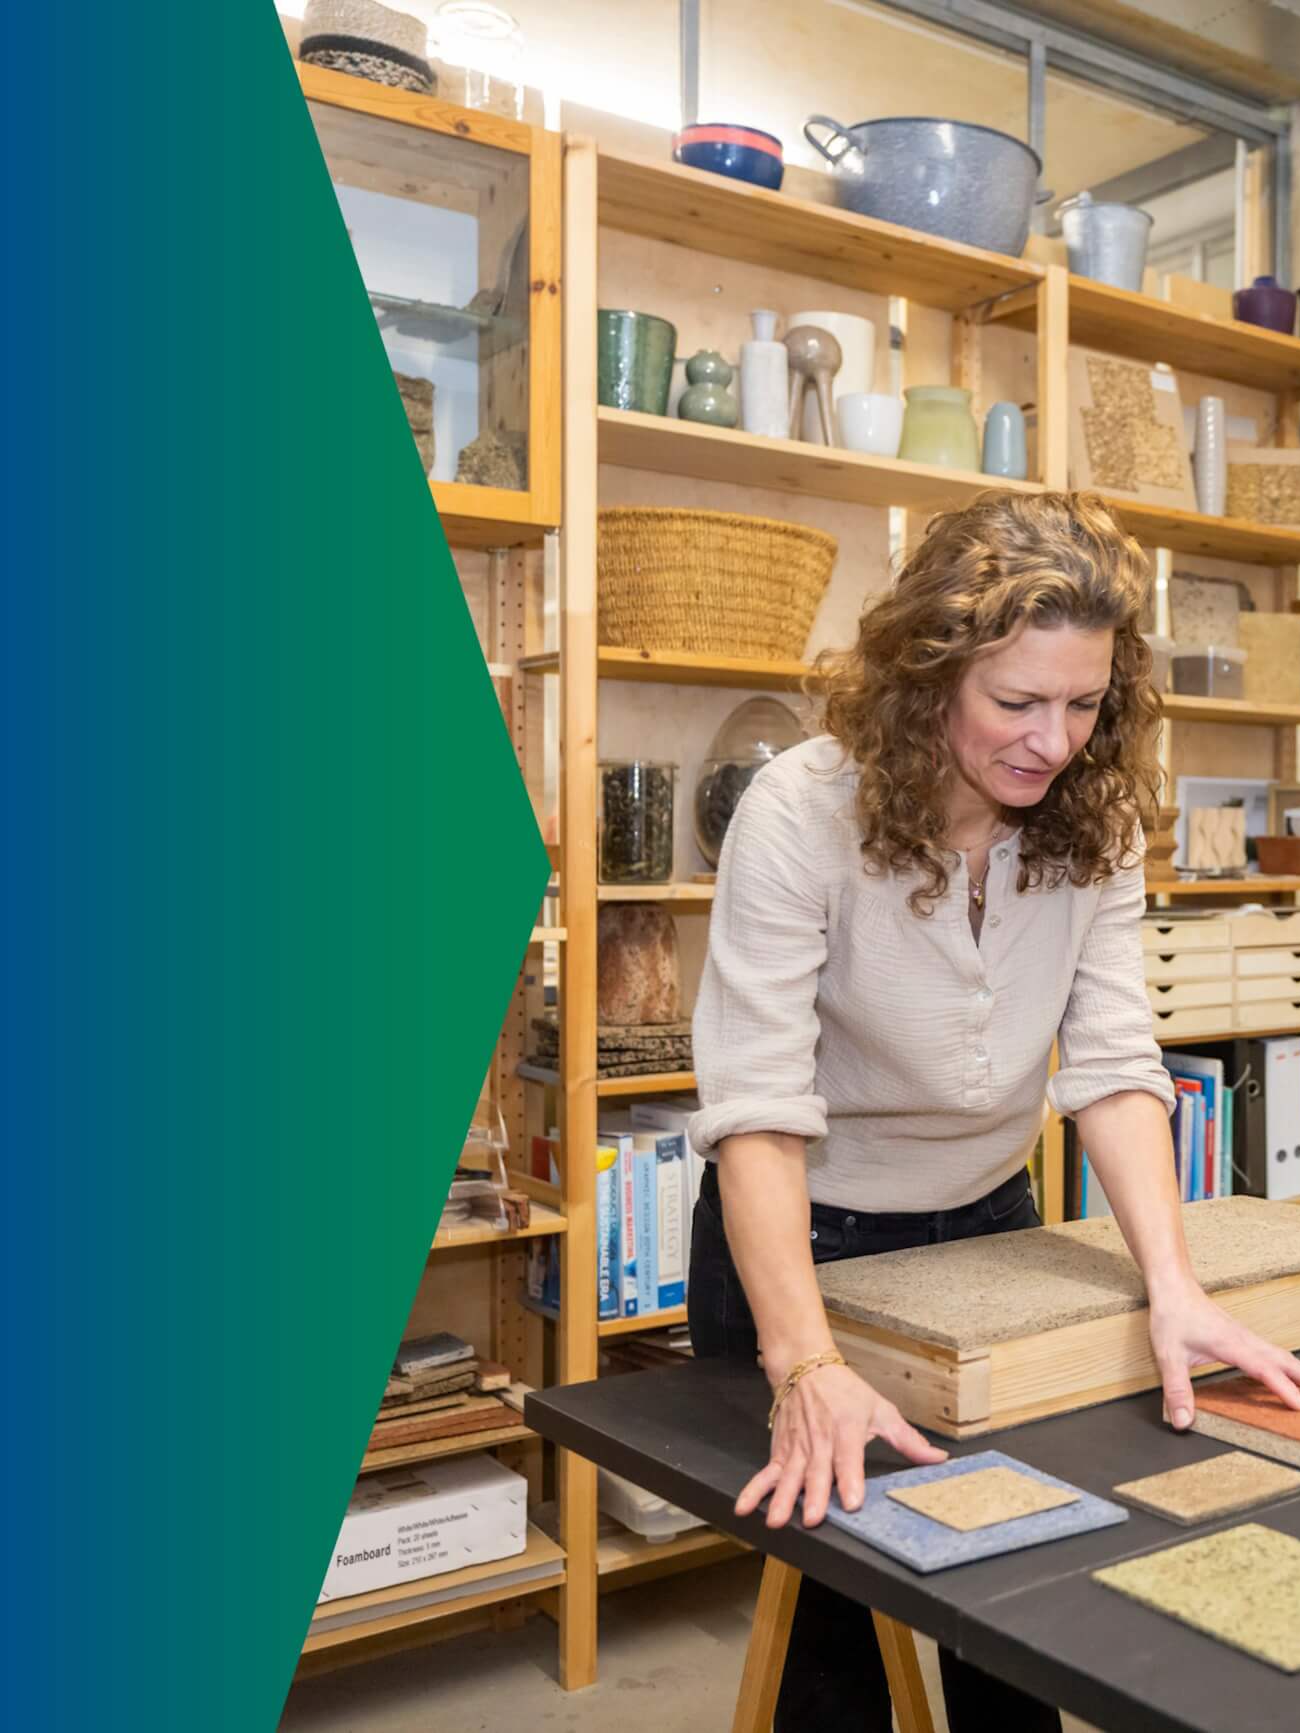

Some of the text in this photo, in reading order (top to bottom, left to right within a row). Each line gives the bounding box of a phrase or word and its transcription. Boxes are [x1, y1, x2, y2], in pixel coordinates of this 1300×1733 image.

[643, 1201, 651, 1233] DESIGN
[666, 1171, 681, 1259] STRATEGY
[626, 1216, 635, 1259] MARKETING
[599, 1279, 610, 1302] ERA
[643, 1259, 651, 1296] CENTURY
[336, 1544, 392, 1568] Foamboard
